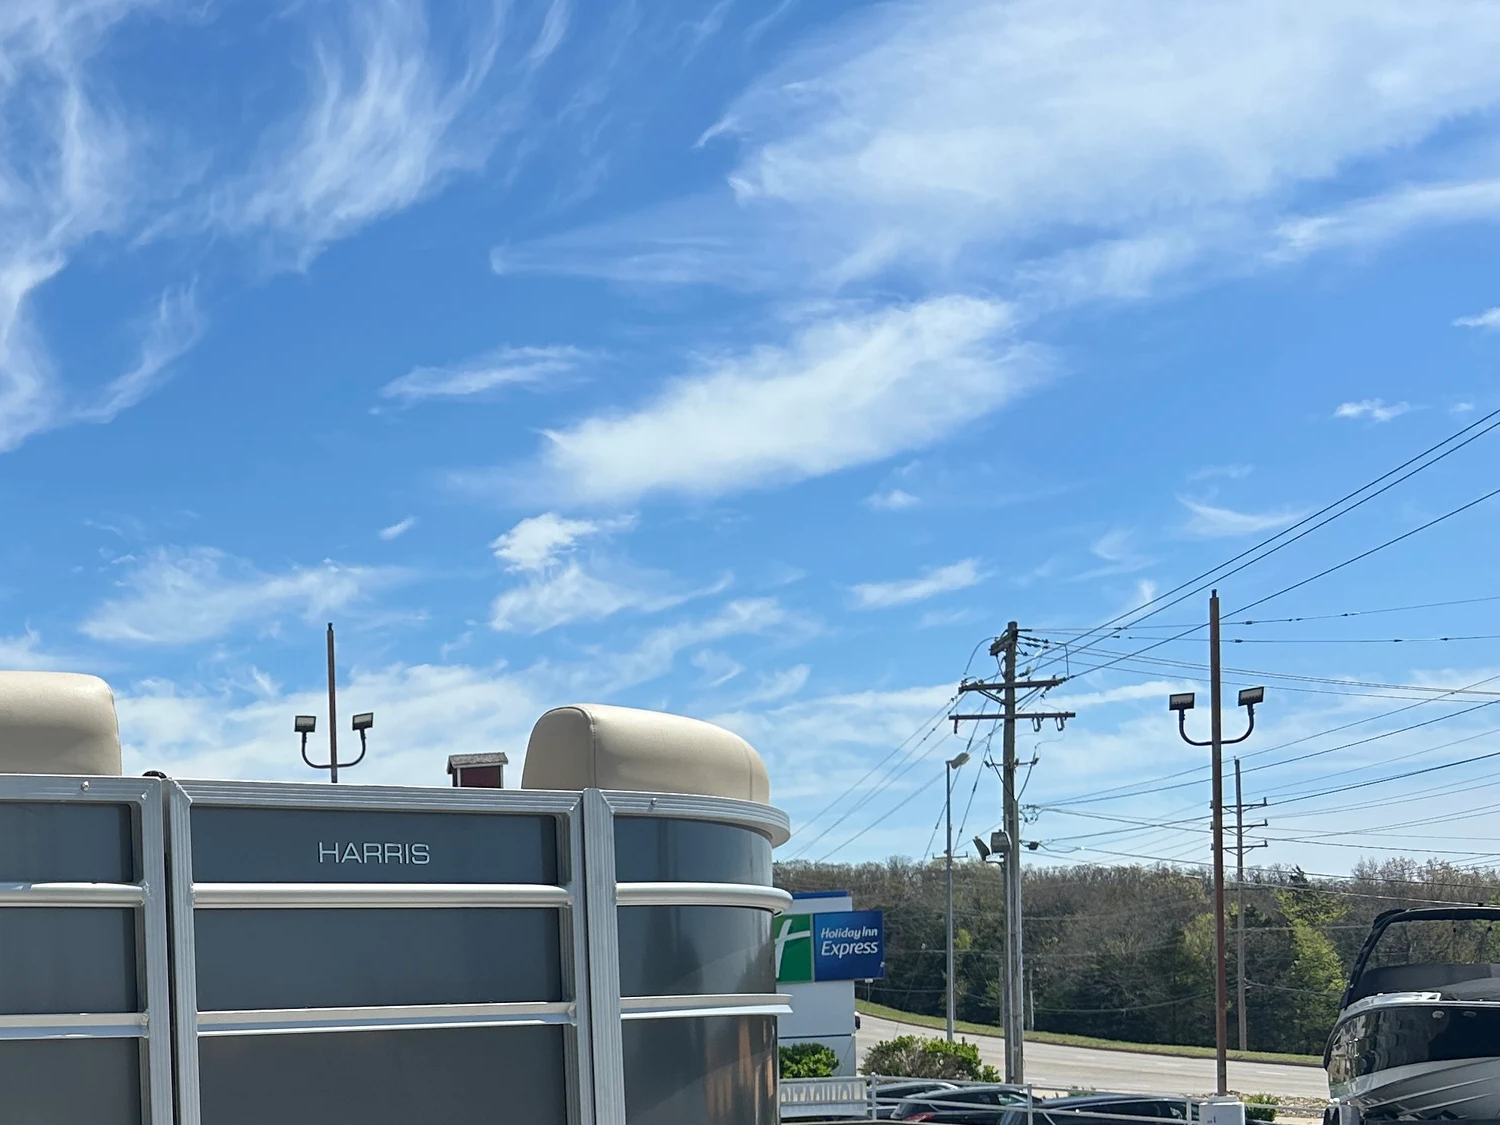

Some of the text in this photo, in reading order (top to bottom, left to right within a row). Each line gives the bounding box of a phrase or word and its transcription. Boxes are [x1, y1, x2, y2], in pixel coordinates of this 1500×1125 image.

[317, 841, 431, 865] HARRIS
[821, 926, 878, 939] Holiday Inn
[821, 941, 878, 959] Express
